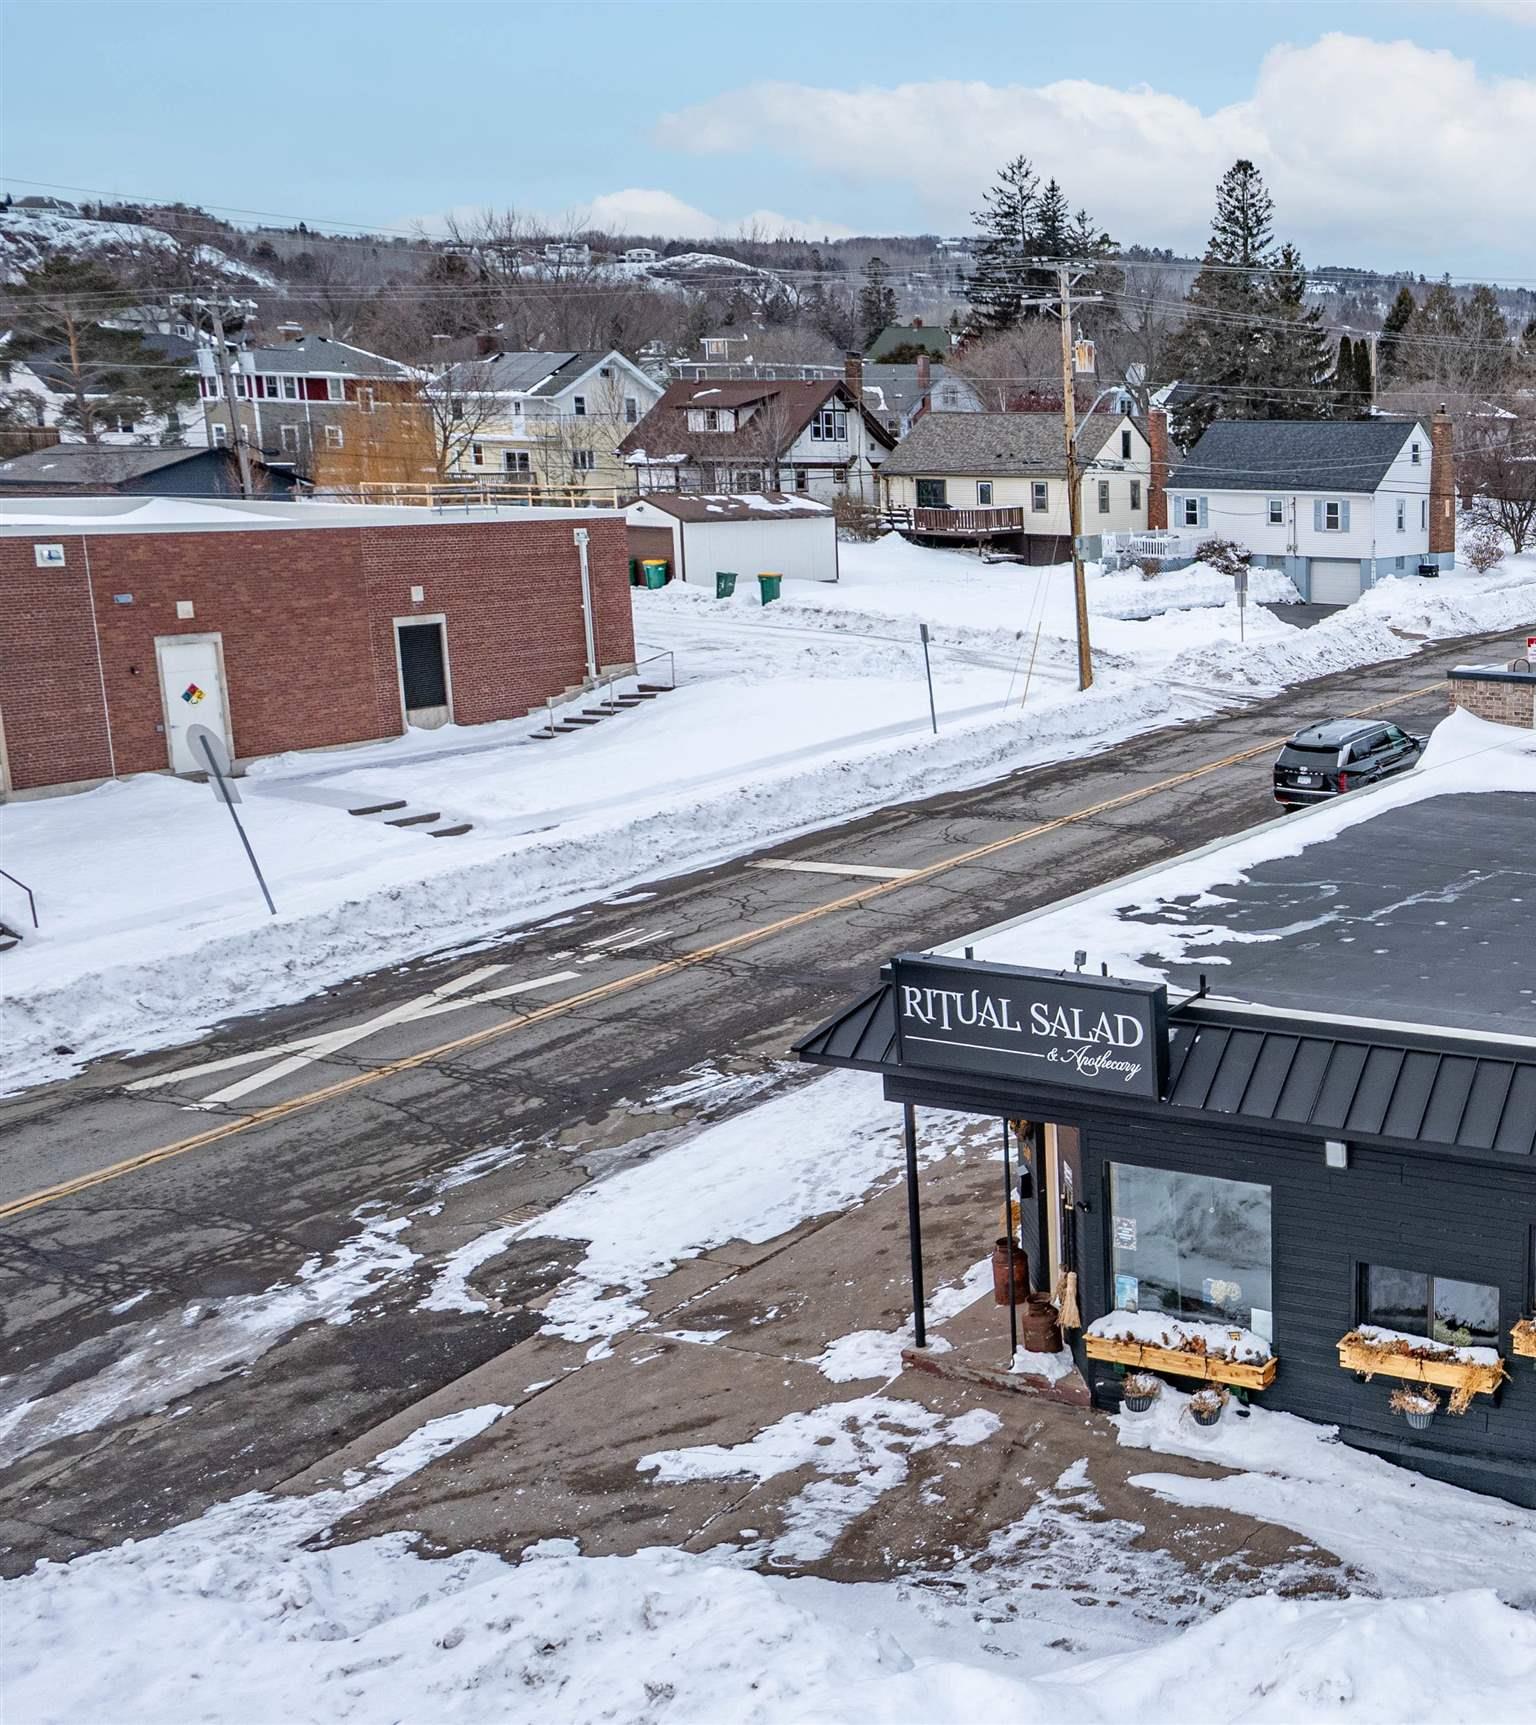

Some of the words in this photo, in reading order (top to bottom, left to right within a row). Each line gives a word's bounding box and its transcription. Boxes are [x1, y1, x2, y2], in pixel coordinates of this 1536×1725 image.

[901, 985, 1022, 1033] RITUAL
[1030, 1002, 1144, 1048] SALAD
[1047, 1047, 1059, 1062] &
[1060, 1044, 1142, 1082] Apothecary
